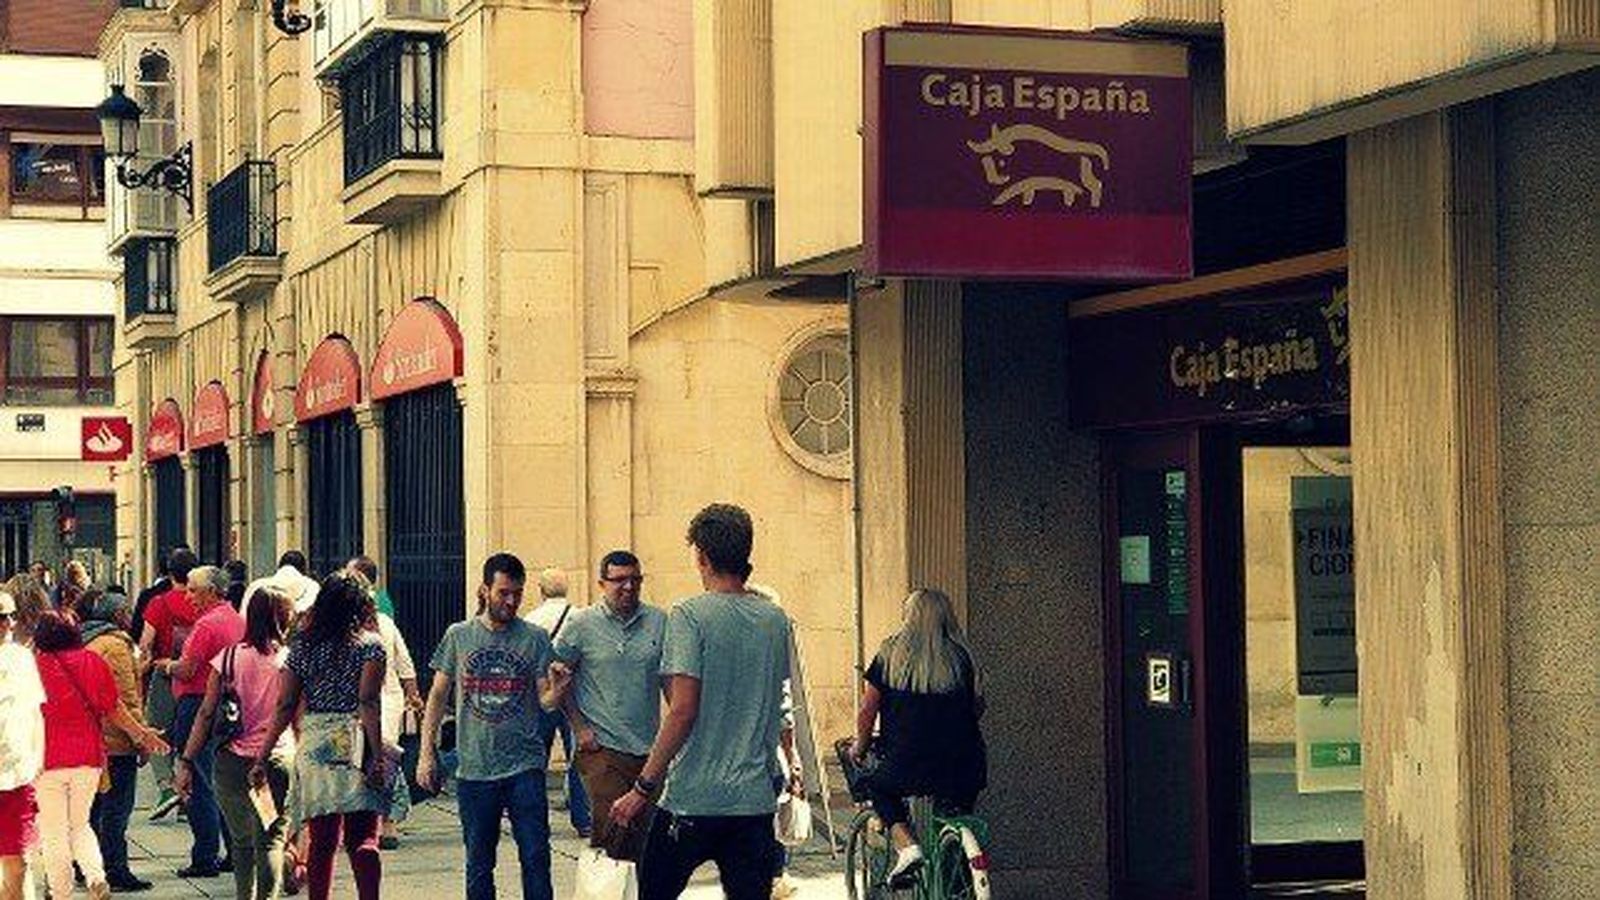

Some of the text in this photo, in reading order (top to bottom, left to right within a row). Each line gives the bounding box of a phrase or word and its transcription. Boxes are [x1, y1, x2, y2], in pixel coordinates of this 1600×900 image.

[920, 73, 1150, 120] Caja España
[1170, 329, 1318, 397] Caja España
